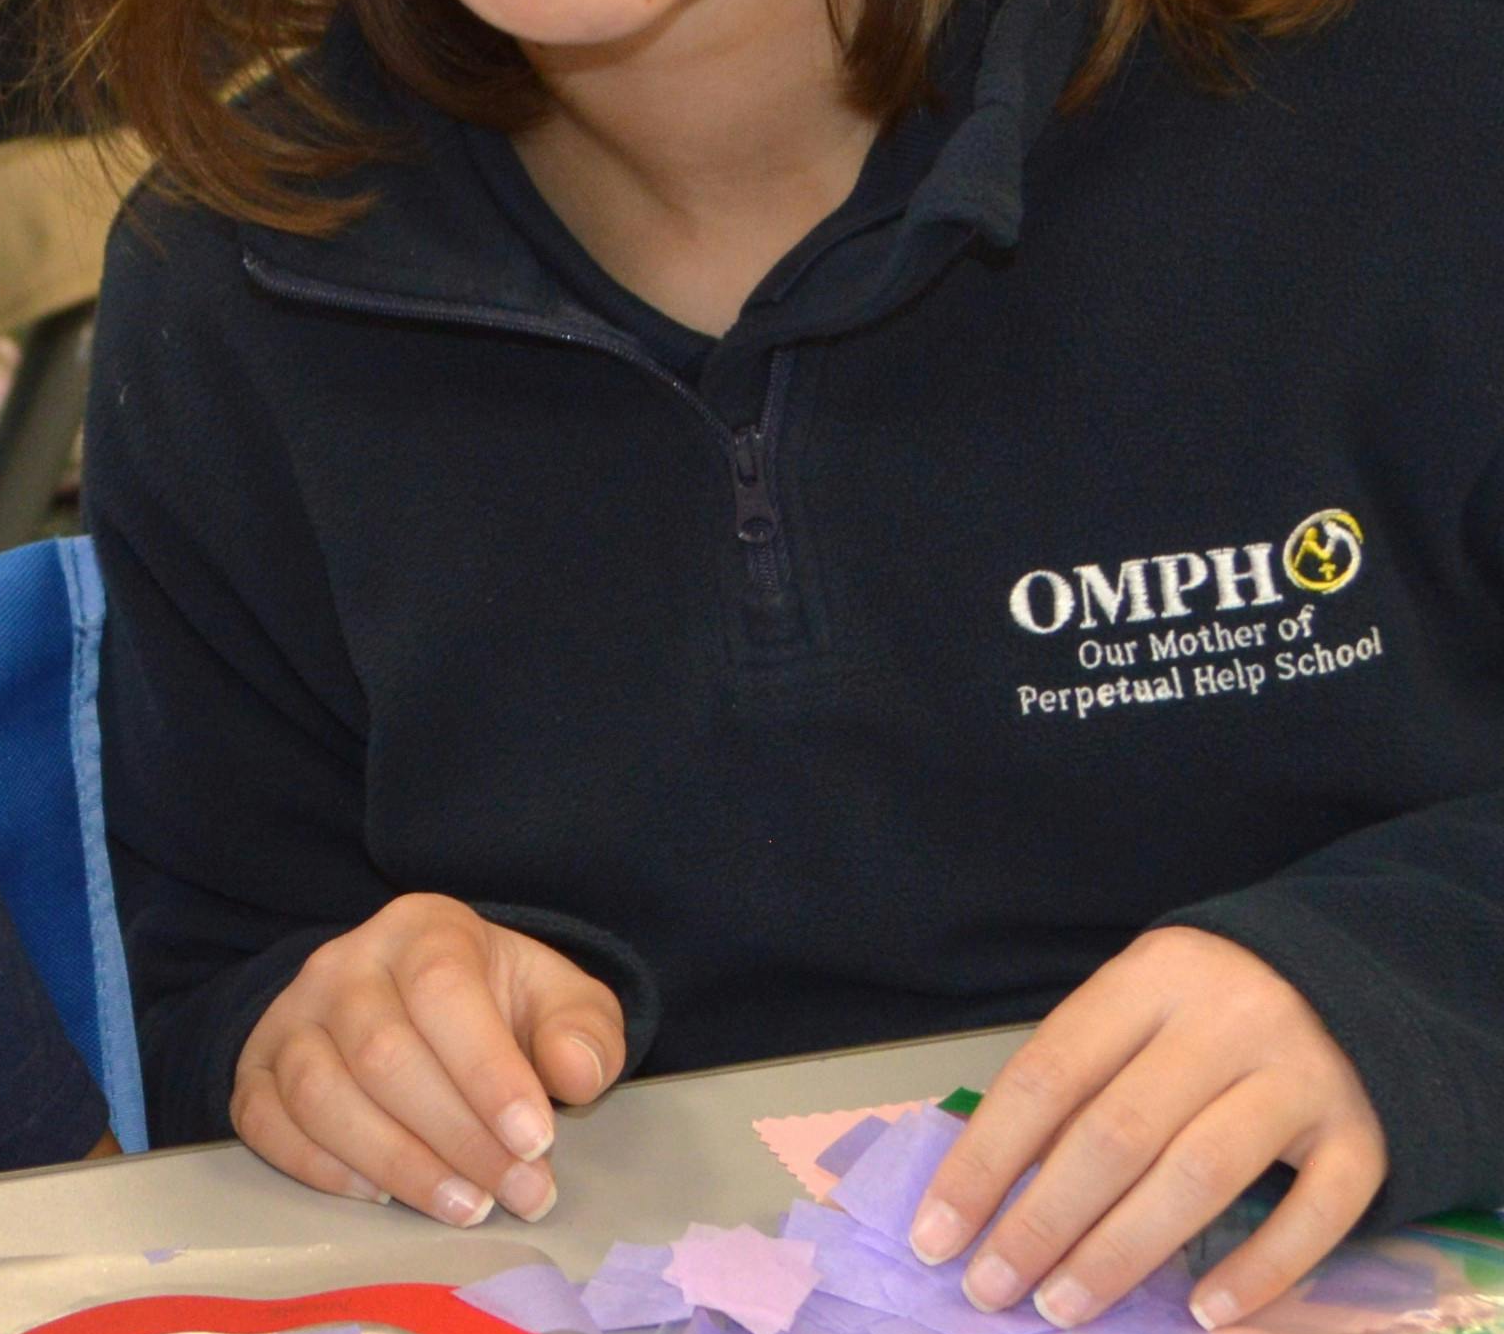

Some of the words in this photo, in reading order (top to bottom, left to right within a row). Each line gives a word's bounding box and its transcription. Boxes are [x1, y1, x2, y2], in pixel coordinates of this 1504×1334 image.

[1009, 542, 1284, 634] OMPH
[1017, 667, 1184, 718] Perpetual
[1192, 658, 1266, 695] Help
[1275, 626, 1384, 680] School
[1078, 639, 1139, 668] Our
[1148, 620, 1267, 662] Mother
[1277, 603, 1316, 640] of
